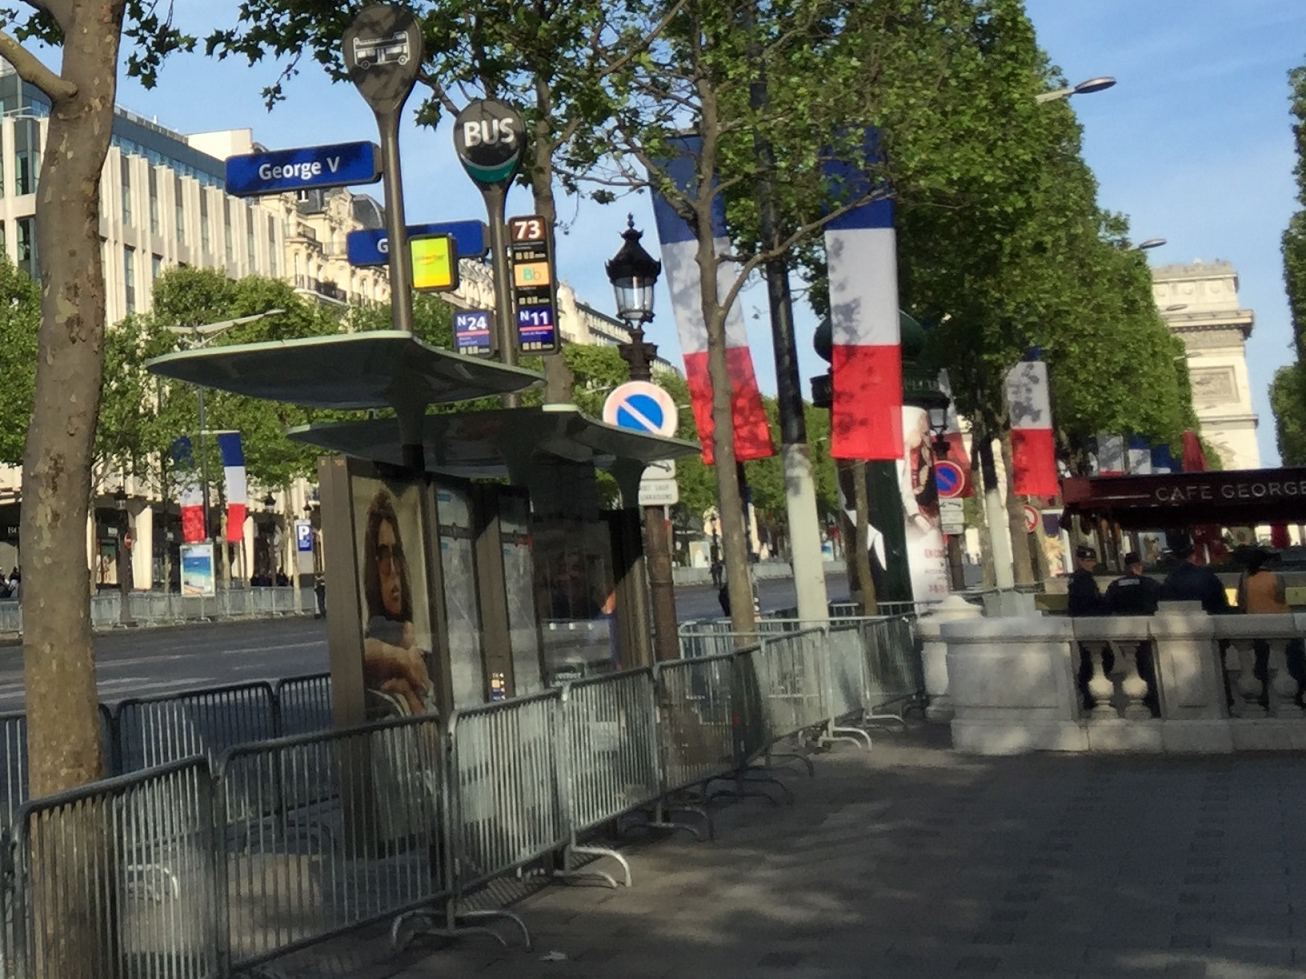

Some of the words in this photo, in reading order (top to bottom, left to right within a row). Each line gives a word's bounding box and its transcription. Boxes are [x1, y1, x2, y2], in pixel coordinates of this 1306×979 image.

[464, 118, 514, 147] BUS
[259, 162, 321, 180] George
[327, 156, 340, 173] V
[514, 220, 541, 239] 73
[1155, 485, 1214, 501] CAFE
[298, 525, 310, 540] P
